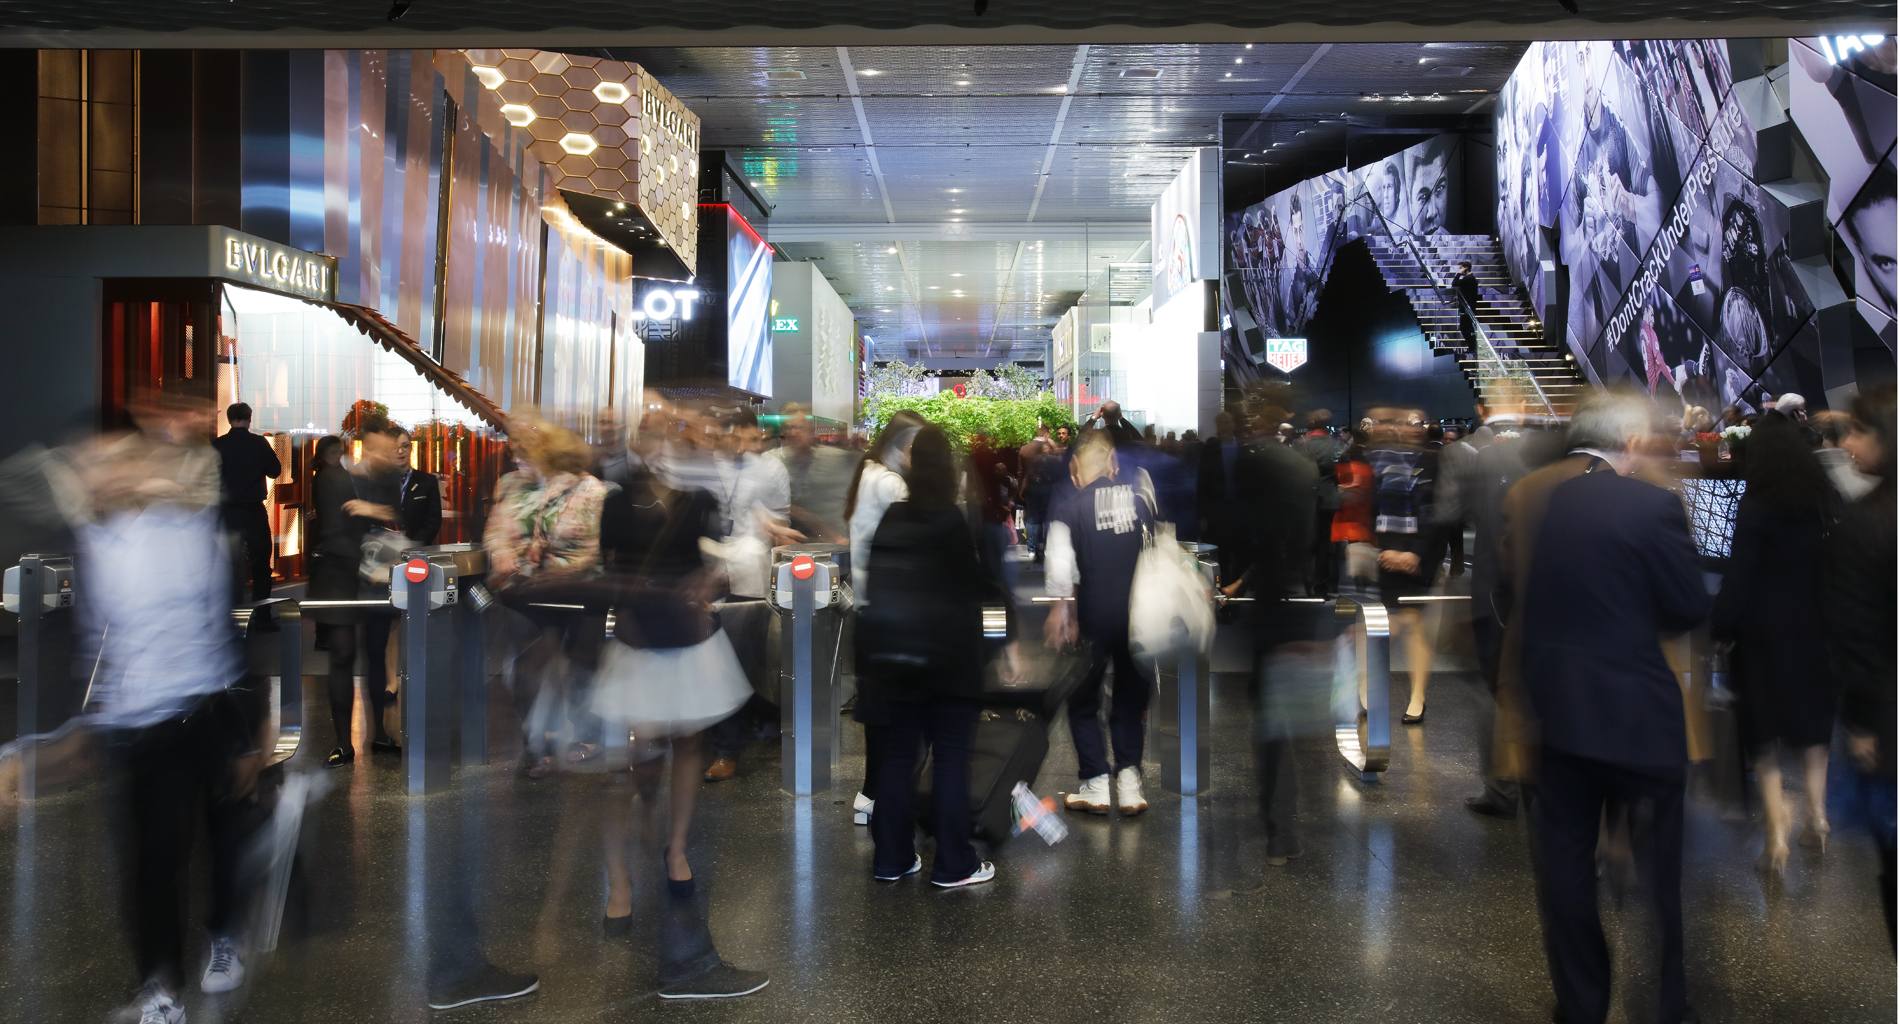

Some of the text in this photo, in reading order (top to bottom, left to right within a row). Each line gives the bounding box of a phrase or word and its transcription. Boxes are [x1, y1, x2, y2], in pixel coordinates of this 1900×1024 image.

[642, 88, 697, 153] BVLGARI
[1606, 102, 1742, 353] #DontCrackUnderPressure
[226, 239, 329, 292] BVLGARI
[771, 319, 798, 331] EX
[1269, 341, 1304, 352] TAG
[1269, 353, 1305, 370] HEUER
